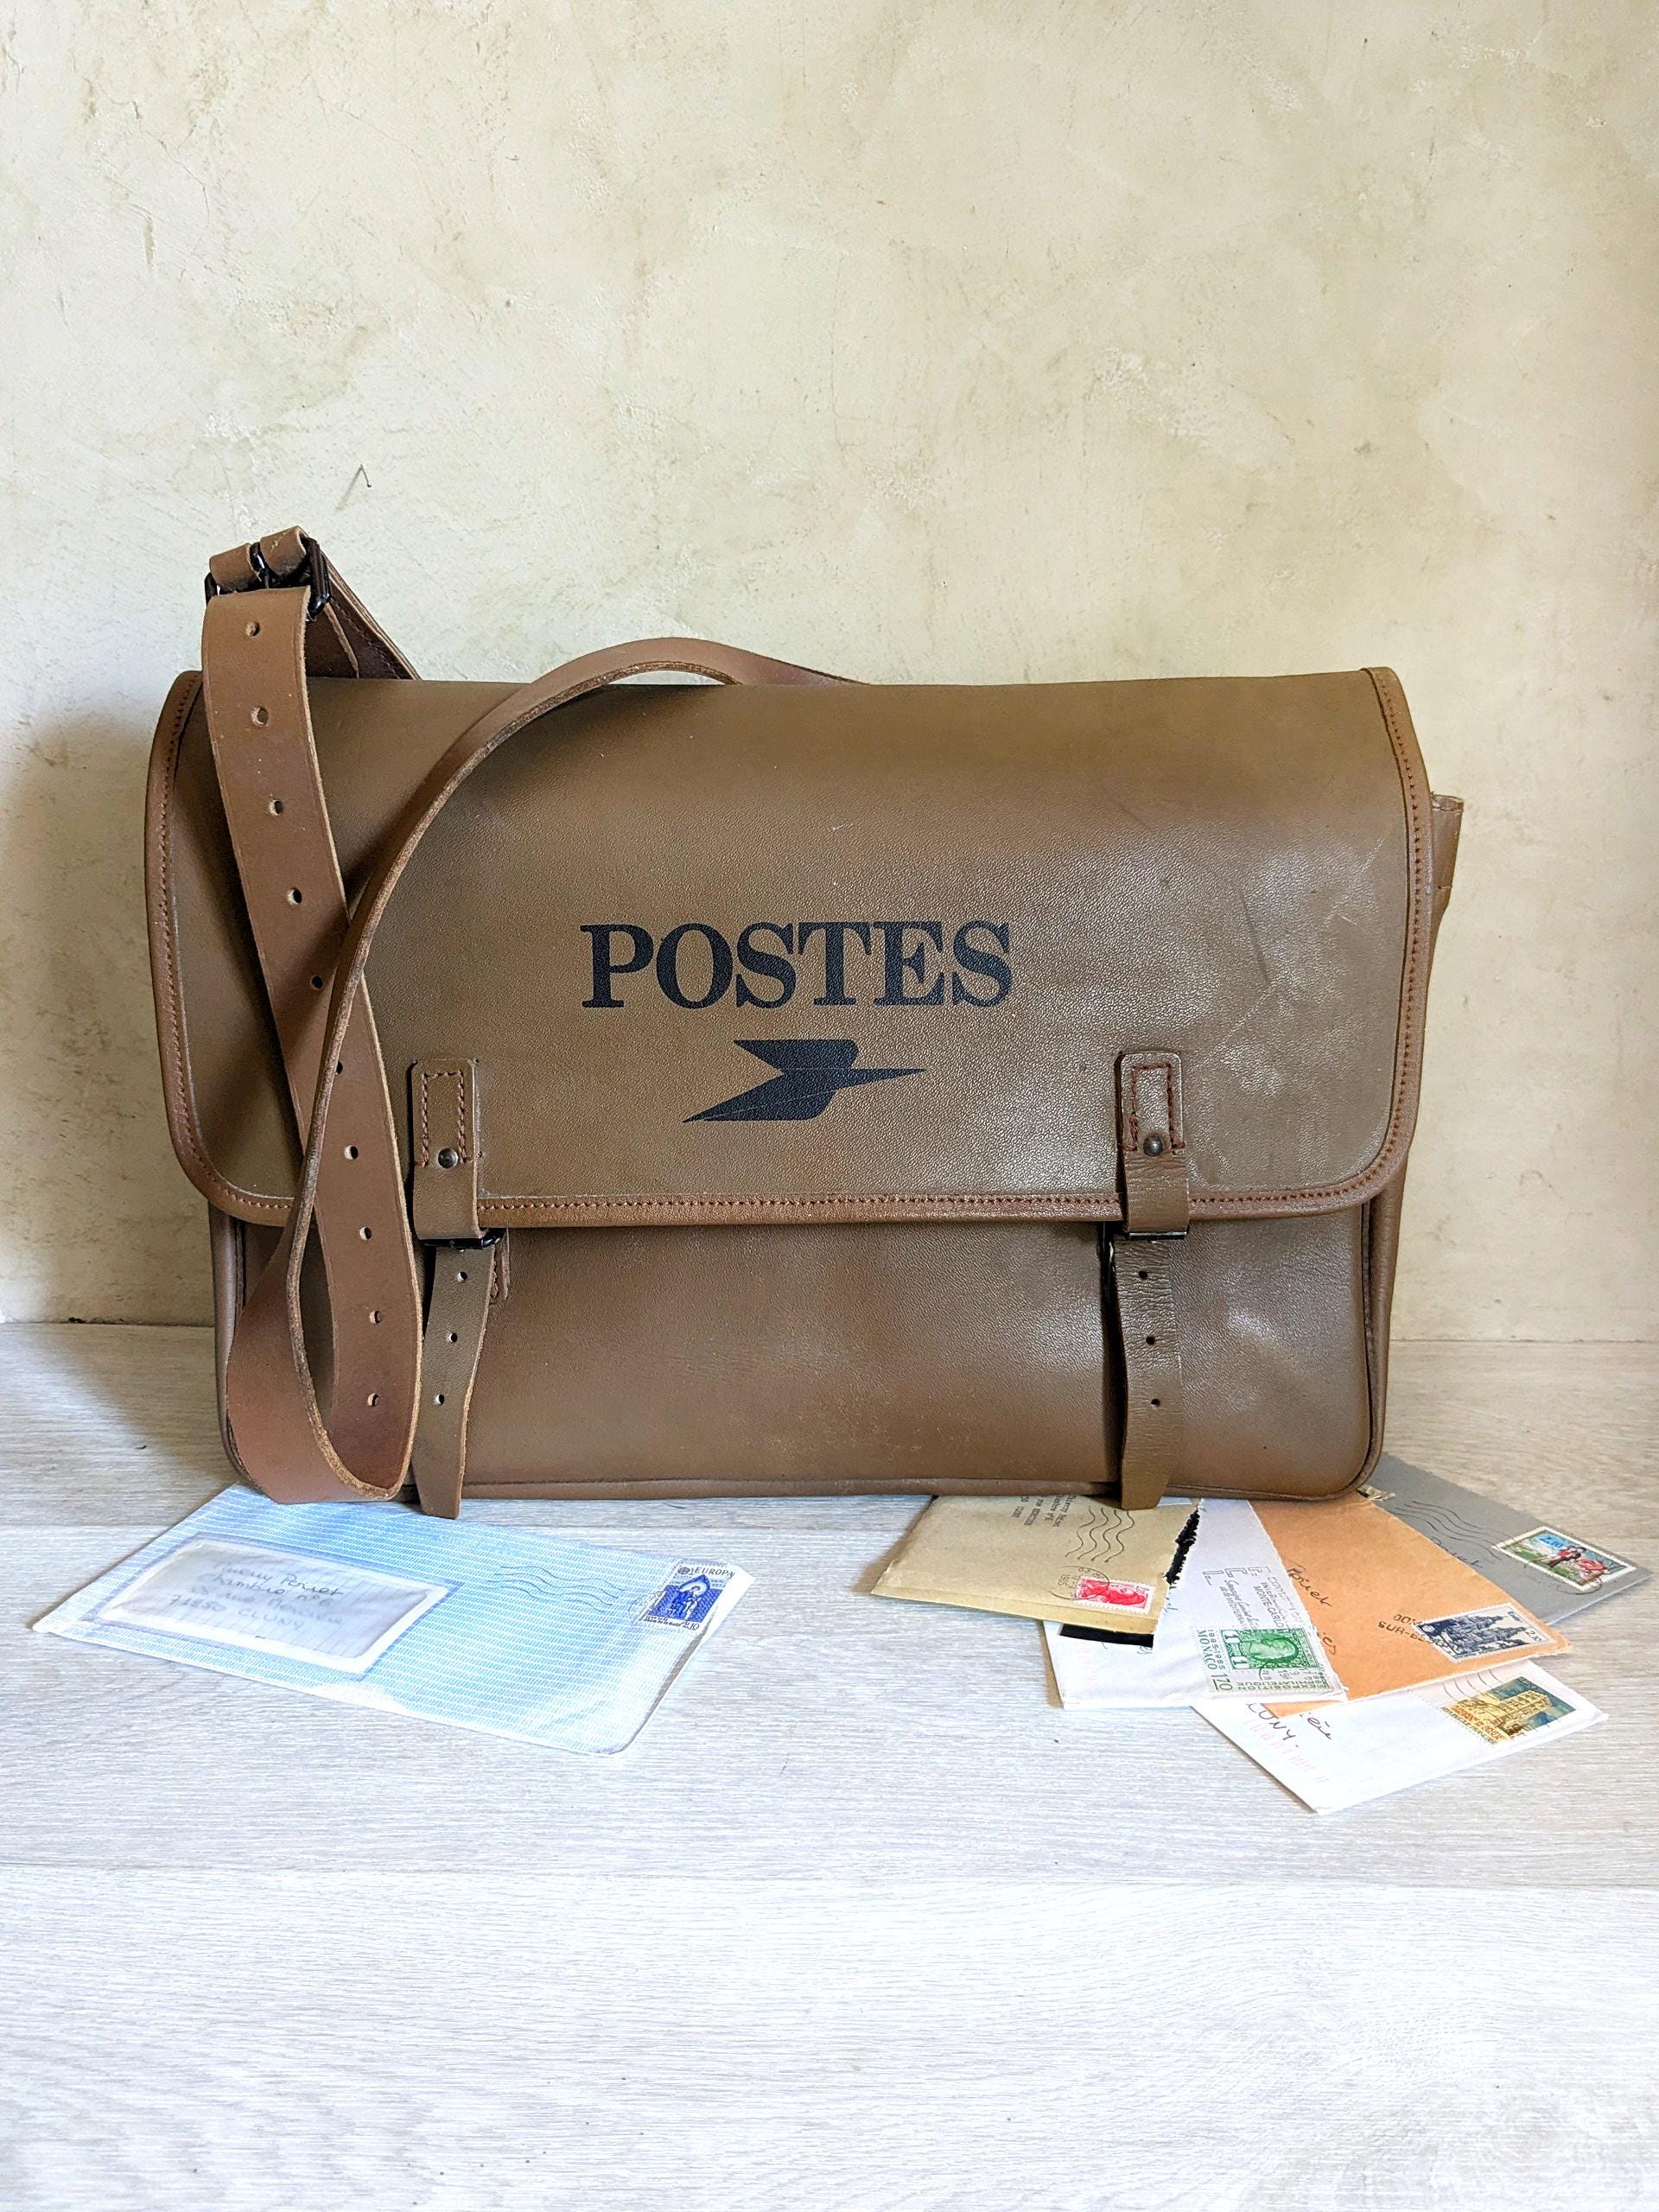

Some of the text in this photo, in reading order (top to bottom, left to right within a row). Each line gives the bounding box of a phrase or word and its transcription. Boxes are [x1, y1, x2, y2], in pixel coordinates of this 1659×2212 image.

[580, 919, 1013, 1009] POSTES
[694, 1566, 735, 1579] EUROPA
[1253, 1585, 1285, 1629] MONTE-CARLO
[1197, 1629, 1218, 1670] MONACO
